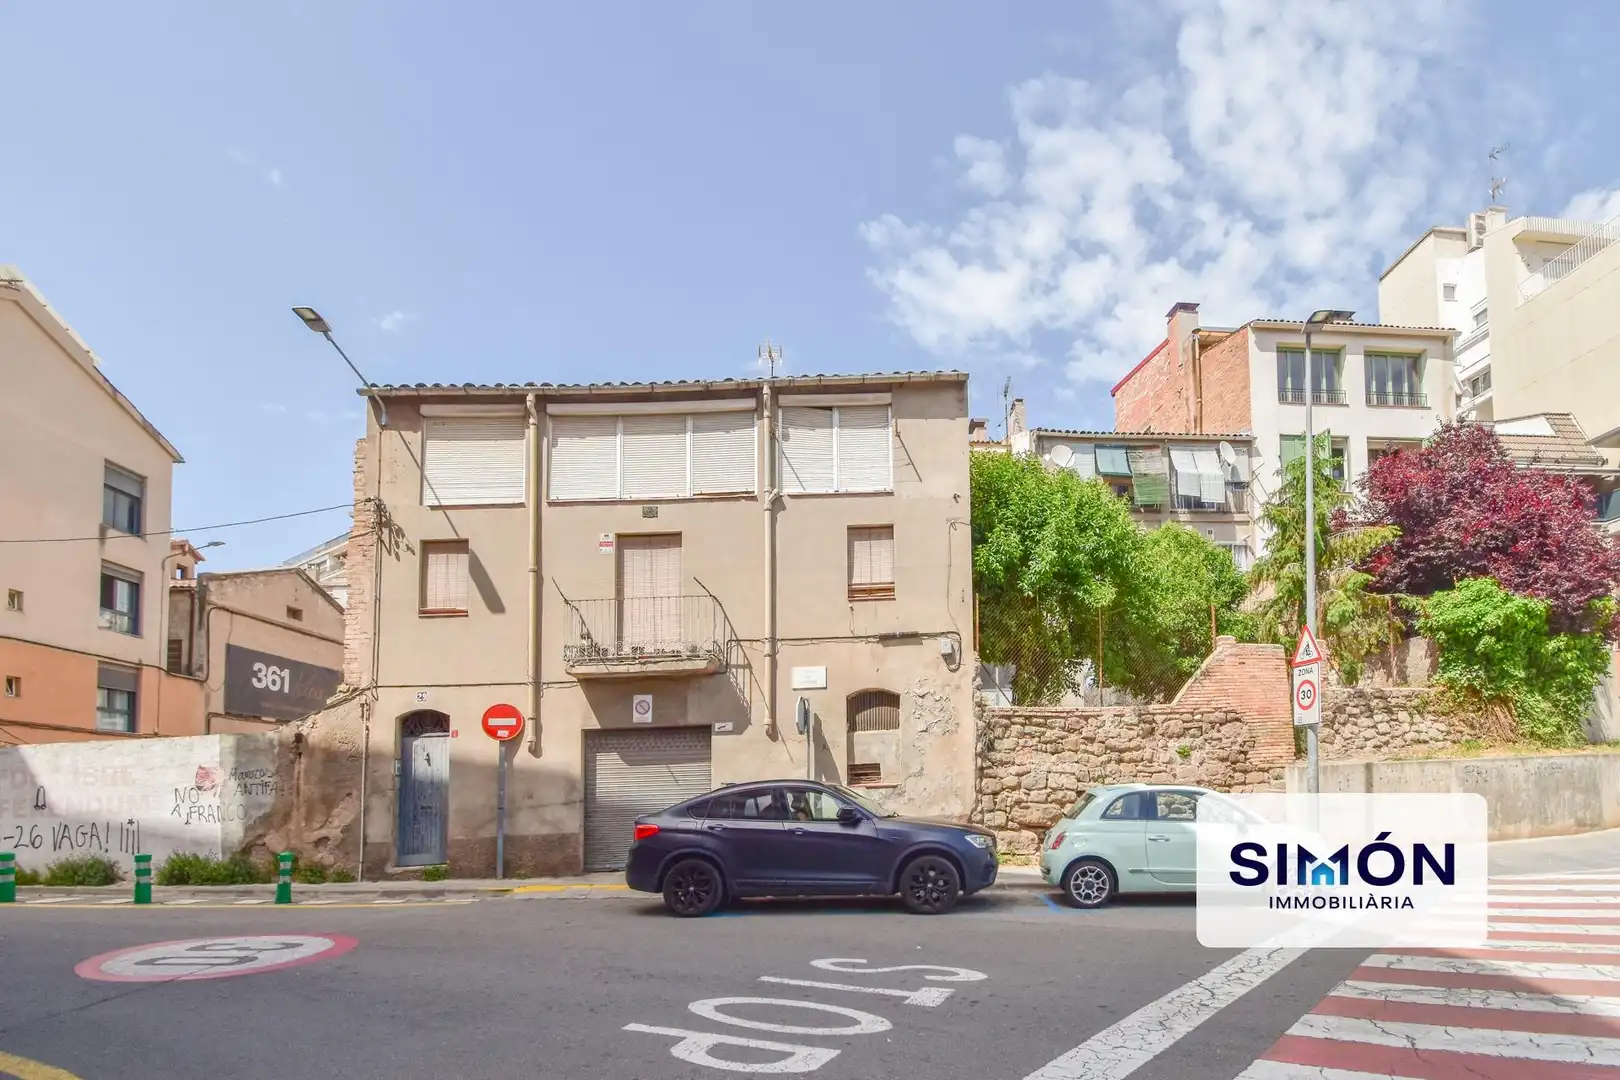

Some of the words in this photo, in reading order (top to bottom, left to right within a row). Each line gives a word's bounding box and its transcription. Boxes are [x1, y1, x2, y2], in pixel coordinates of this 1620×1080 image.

[251, 662, 290, 694] 361
[1297, 667, 1314, 677] ZONA
[1300, 689, 1312, 700] 30
[174, 786, 200, 804] NO
[170, 803, 182, 818] A
[52, 821, 110, 853] VAGA!
[133, 942, 304, 967] 30
[620, 957, 989, 1074] STOP
